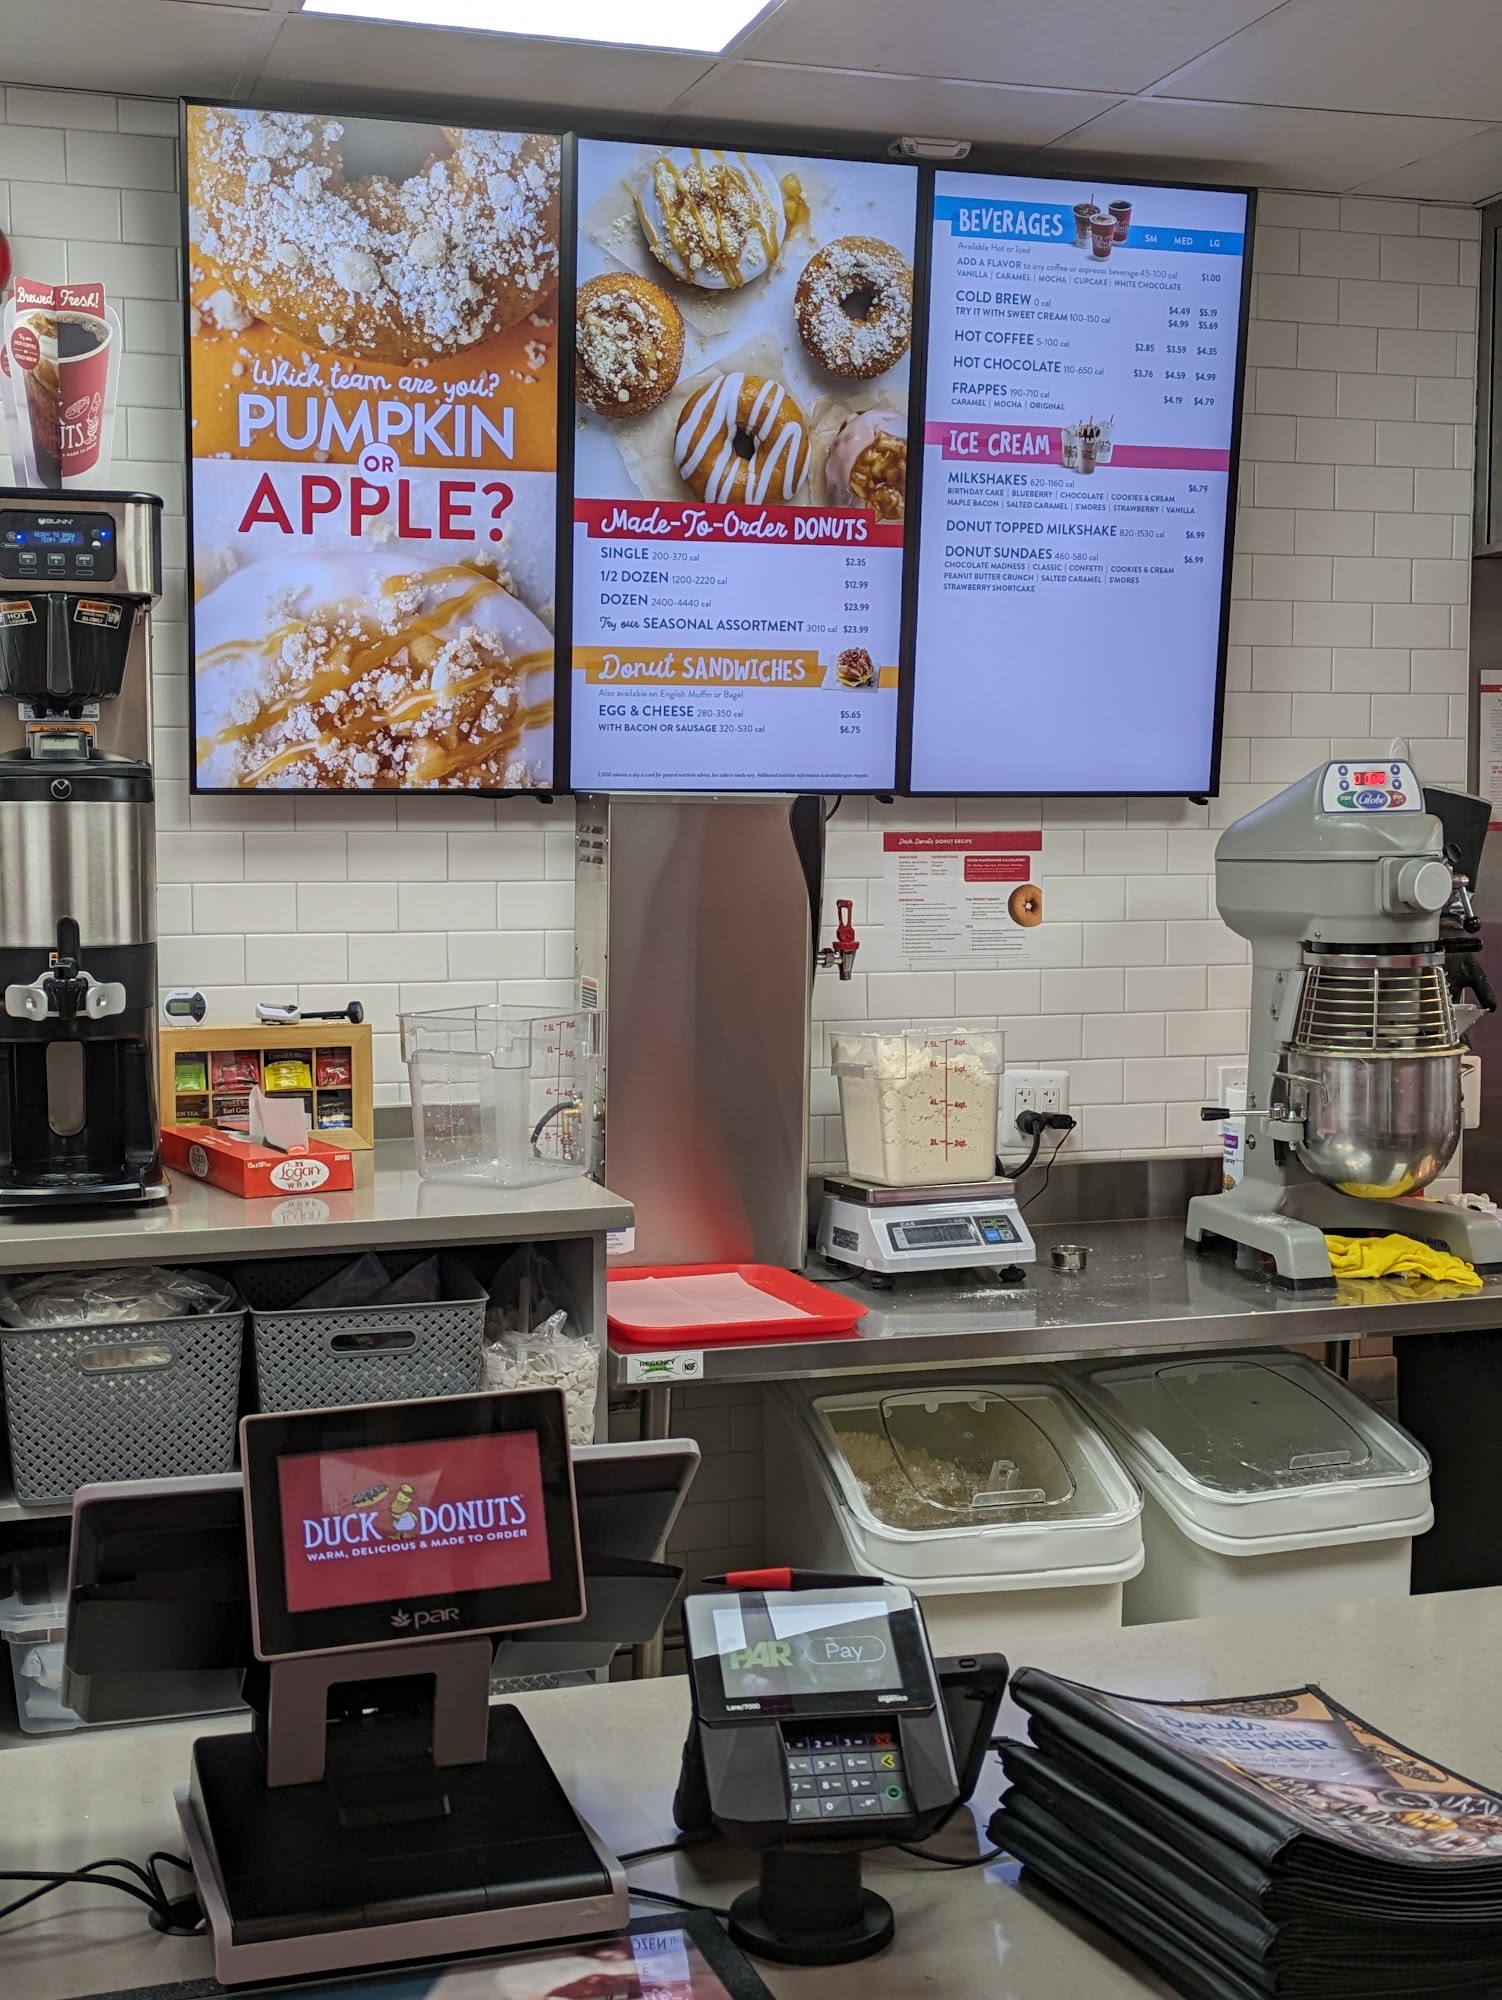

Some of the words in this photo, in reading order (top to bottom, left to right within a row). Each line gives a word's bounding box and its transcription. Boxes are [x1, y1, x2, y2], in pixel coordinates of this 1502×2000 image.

[960, 207, 1063, 236] BEVERAGES
[1145, 234, 1158, 243] SM
[1174, 236, 1193, 246] MED
[1210, 238, 1220, 247] LG
[1202, 274, 1220, 282] $1.00
[17, 286, 55, 305] Brewed
[60, 289, 99, 308] Fresh!
[956, 290, 991, 303] COLD
[996, 293, 1031, 306] BREW
[1034, 298, 1039, 306] 0
[1042, 298, 1051, 307] cal
[956, 307, 970, 316] TRY
[973, 308, 982, 316] IT
[983, 308, 1004, 318] WITH
[1007, 310, 1034, 319] SWEET
[1037, 311, 1067, 321] CREAM
[1070, 314, 1099, 323] 100-150
[1102, 315, 1110, 324] cal
[1169, 306, 1190, 316] $4.49
[1200, 307, 1217, 318] $5.19
[1168, 319, 1188, 328] $4.99
[1199, 321, 1218, 330] $5.69
[23, 341, 37, 349] COFFEE
[955, 330, 981, 342] HOT
[985, 332, 1034, 345] COFFEE
[1036, 338, 1058, 347] 5-100
[1060, 338, 1069, 348] cal
[1135, 343, 1154, 352] $2.85
[1167, 345, 1186, 354] $3.59
[1197, 346, 1217, 356] $4.35
[954, 356, 980, 368] HOT
[984, 358, 1060, 373] CHOCOLATE
[1064, 365, 1092, 375] 110-650
[1095, 368, 1104, 376] cal
[253, 359, 323, 388] Which
[330, 361, 392, 390] team
[398, 377, 437, 394] are
[443, 373, 499, 402] you?
[1134, 369, 1153, 378] $3.76
[1165, 370, 1185, 380] $4.59
[1196, 372, 1215, 382] $4.99
[952, 382, 1006, 396] FRAPPES
[1010, 388, 1038, 398] 190-710
[1040, 390, 1050, 398] cal
[1164, 396, 1182, 405] $4.19
[1194, 397, 1214, 406] $4.79
[238, 393, 513, 459] PUMPKIN
[950, 430, 979, 455] ICE
[988, 430, 1049, 456] CREAM
[364, 455, 393, 473] OR
[948, 472, 1027, 486] MILKSHAKES
[1030, 478, 1063, 487] 620-1160
[1066, 480, 1074, 488] cal
[1188, 484, 1208, 493] $6.79
[238, 472, 513, 541] APPLE?
[601, 507, 788, 537] Made-To-Order
[794, 517, 867, 540] DONUTS
[946, 520, 992, 532] DONUT
[996, 521, 1043, 534] TOPPED
[1047, 524, 1116, 537] MILKSHAKE
[1120, 529, 1154, 538] 820-1530
[1156, 530, 1164, 539] cal
[1186, 530, 1205, 540] $6.99
[601, 547, 649, 560] SINGLE
[652, 552, 687, 561] 200-370
[690, 553, 699, 561] cal
[946, 546, 991, 558] DONUT
[994, 547, 1052, 560] SUNDAES
[1055, 552, 1087, 561] 460-580
[1090, 553, 1098, 562] cal
[1184, 555, 1203, 565] $6.99
[846, 558, 866, 567] $2.35
[601, 570, 617, 582] 1/2
[621, 571, 668, 583] DOZEN
[672, 575, 715, 585] 1200-2220
[717, 577, 727, 585] cal
[845, 580, 868, 590] $12.99
[944, 583, 990, 592] STRAWBERRY
[992, 584, 1035, 592] SHORTCAKE
[601, 594, 648, 606] DOZEN
[651, 598, 699, 607] 2400-4440
[701, 599, 711, 608] cal
[844, 603, 869, 612] $23.99
[600, 616, 617, 631] Try
[620, 619, 640, 630] our
[643, 617, 713, 631] SEASONAL
[717, 619, 804, 632] ASSORTMENT
[807, 624, 826, 633] 3010
[828, 625, 837, 633] cal
[844, 625, 868, 634] $23.99
[598, 653, 676, 680] Donut
[682, 656, 806, 683] SANDWICHES
[598, 689, 614, 698] Also
[617, 689, 646, 698] available
[661, 690, 684, 701] English
[687, 690, 712, 699] Muffin
[724, 690, 743, 701] Bagel
[599, 705, 626, 716] EGG
[630, 705, 639, 717] &
[643, 705, 694, 718] CHEESE
[697, 709, 731, 718] 280-350
[734, 710, 743, 718] cal
[840, 710, 861, 719] $5.65
[598, 723, 622, 732] WITH
[624, 724, 658, 732] BACON
[660, 724, 673, 732] OR
[675, 724, 717, 733] SAUSAGE
[719, 724, 753, 733] 320-530
[755, 725, 764, 733] cal
[840, 725, 860, 734] $6.75
[1359, 792, 1385, 804] Globe
[280, 1163, 321, 1181] Logan
[640, 1359, 675, 1367] REGENCY
[303, 1512, 382, 1548] DUCK
[419, 1495, 526, 1536] DONUTS
[307, 1548, 348, 1562] WARM,
[352, 1542, 416, 1557] DELICIOUS
[419, 1540, 428, 1548] &
[431, 1537, 465, 1547] MADE
[468, 1534, 484, 1542] TO
[487, 1529, 527, 1541] ORDER
[414, 1607, 459, 1629] par
[730, 1641, 794, 1670] PAR
[824, 1642, 863, 1660] Pay
[1159, 1715, 1267, 1731] Donuts
